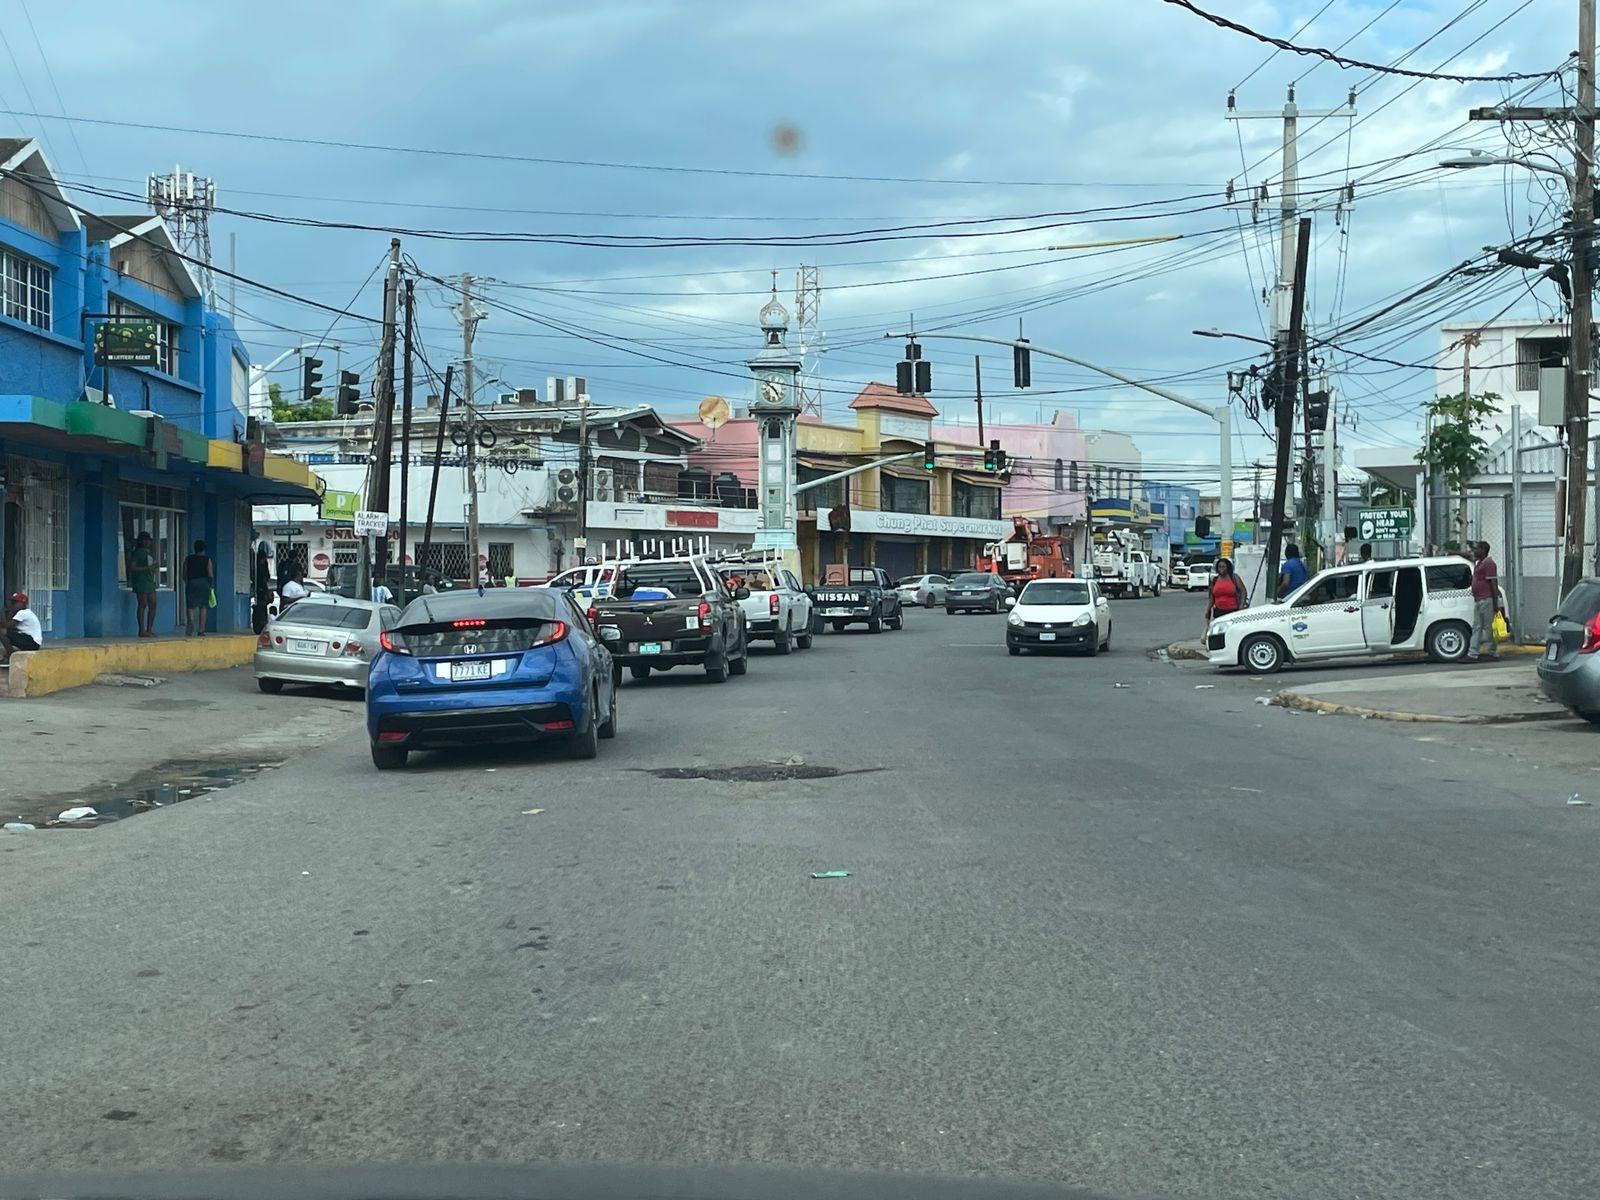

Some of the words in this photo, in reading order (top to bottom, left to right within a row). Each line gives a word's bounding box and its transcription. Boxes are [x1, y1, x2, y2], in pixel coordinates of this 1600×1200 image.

[1360, 511, 1388, 519] PROTECT
[1390, 510, 1408, 518] YOUR
[357, 520, 386, 528] TRACKER
[876, 514, 911, 533] Chung
[939, 518, 1003, 537] Supermarket
[816, 593, 860, 602] NISSAN
[453, 665, 475, 677] 7771
[477, 664, 488, 675] KE
